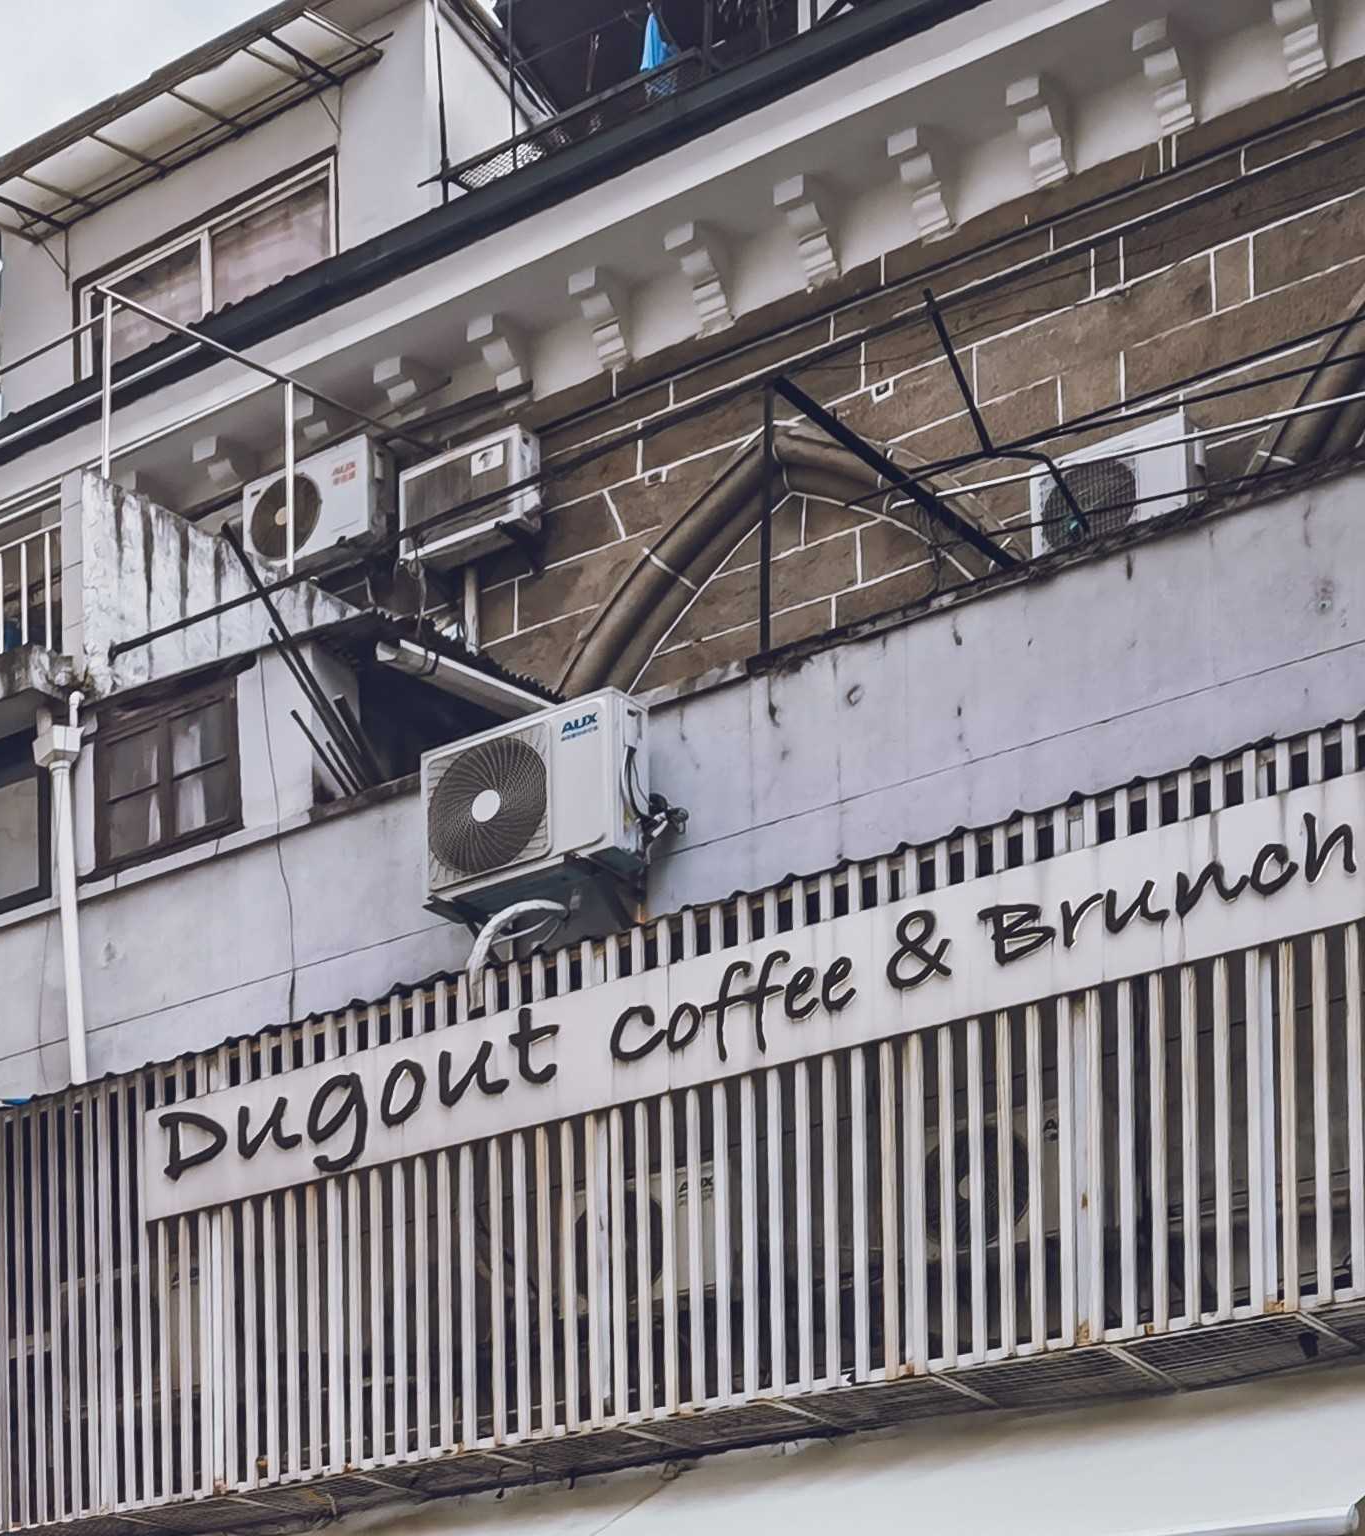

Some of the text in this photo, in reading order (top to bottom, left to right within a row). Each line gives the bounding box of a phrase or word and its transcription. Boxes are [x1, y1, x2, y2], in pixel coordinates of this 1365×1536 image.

[561, 712, 598, 734] AUX
[158, 1007, 560, 1182] Dugout
[885, 909, 952, 990] &
[977, 812, 1358, 966] Brunch
